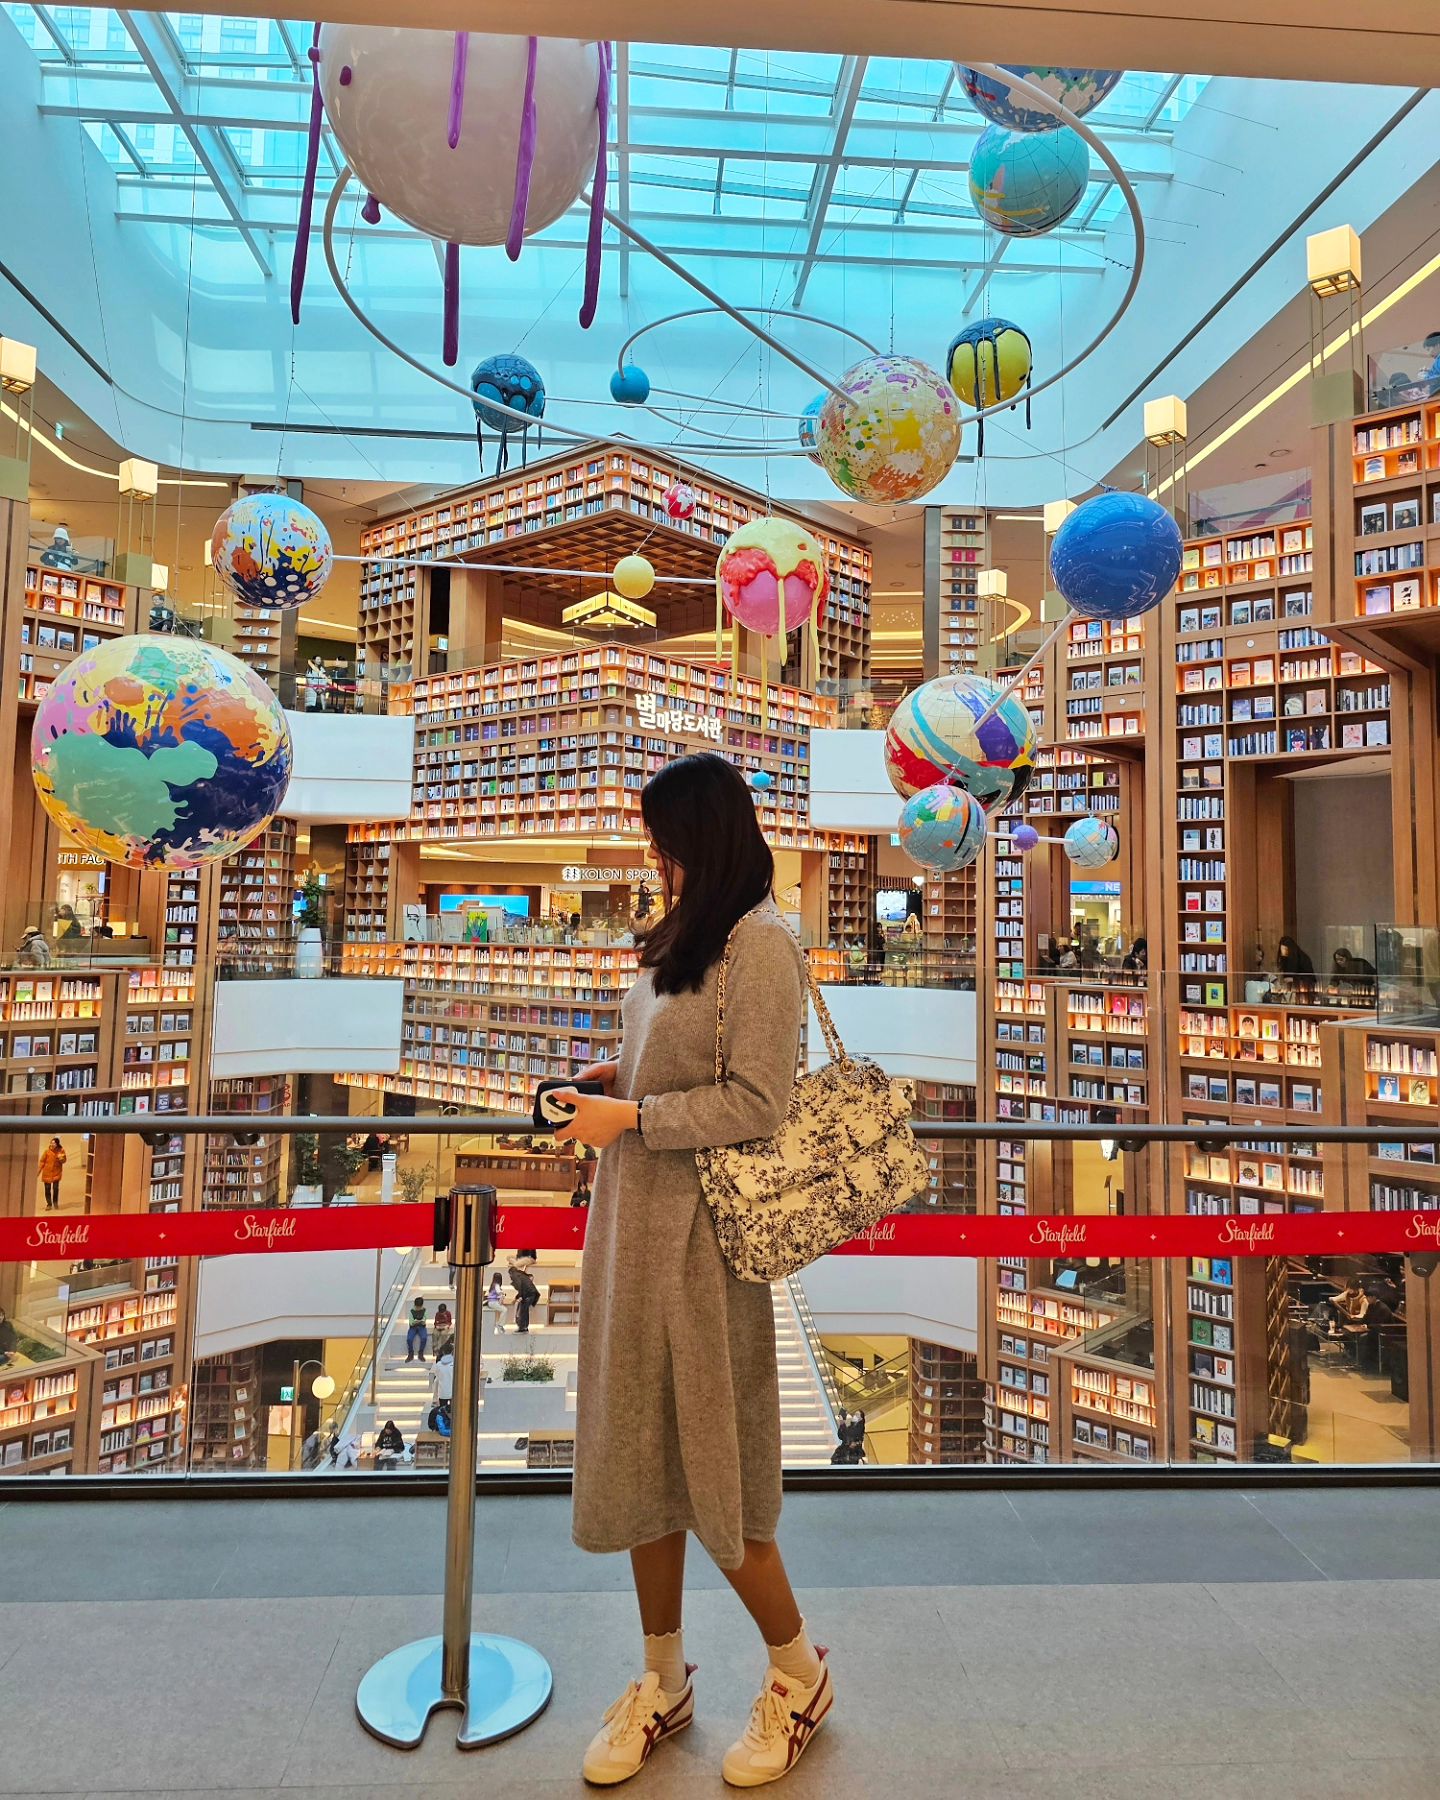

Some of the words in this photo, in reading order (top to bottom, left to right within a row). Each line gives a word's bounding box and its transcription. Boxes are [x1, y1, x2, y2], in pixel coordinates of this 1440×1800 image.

[80, 853, 106, 865] FAC
[580, 868, 621, 881] KOLON
[26, 1221, 90, 1255] Starfield
[234, 1214, 297, 1248] Starfield
[847, 1222, 896, 1251] arfield
[1029, 1220, 1086, 1252] Starfield
[1218, 1219, 1275, 1251] Starfield
